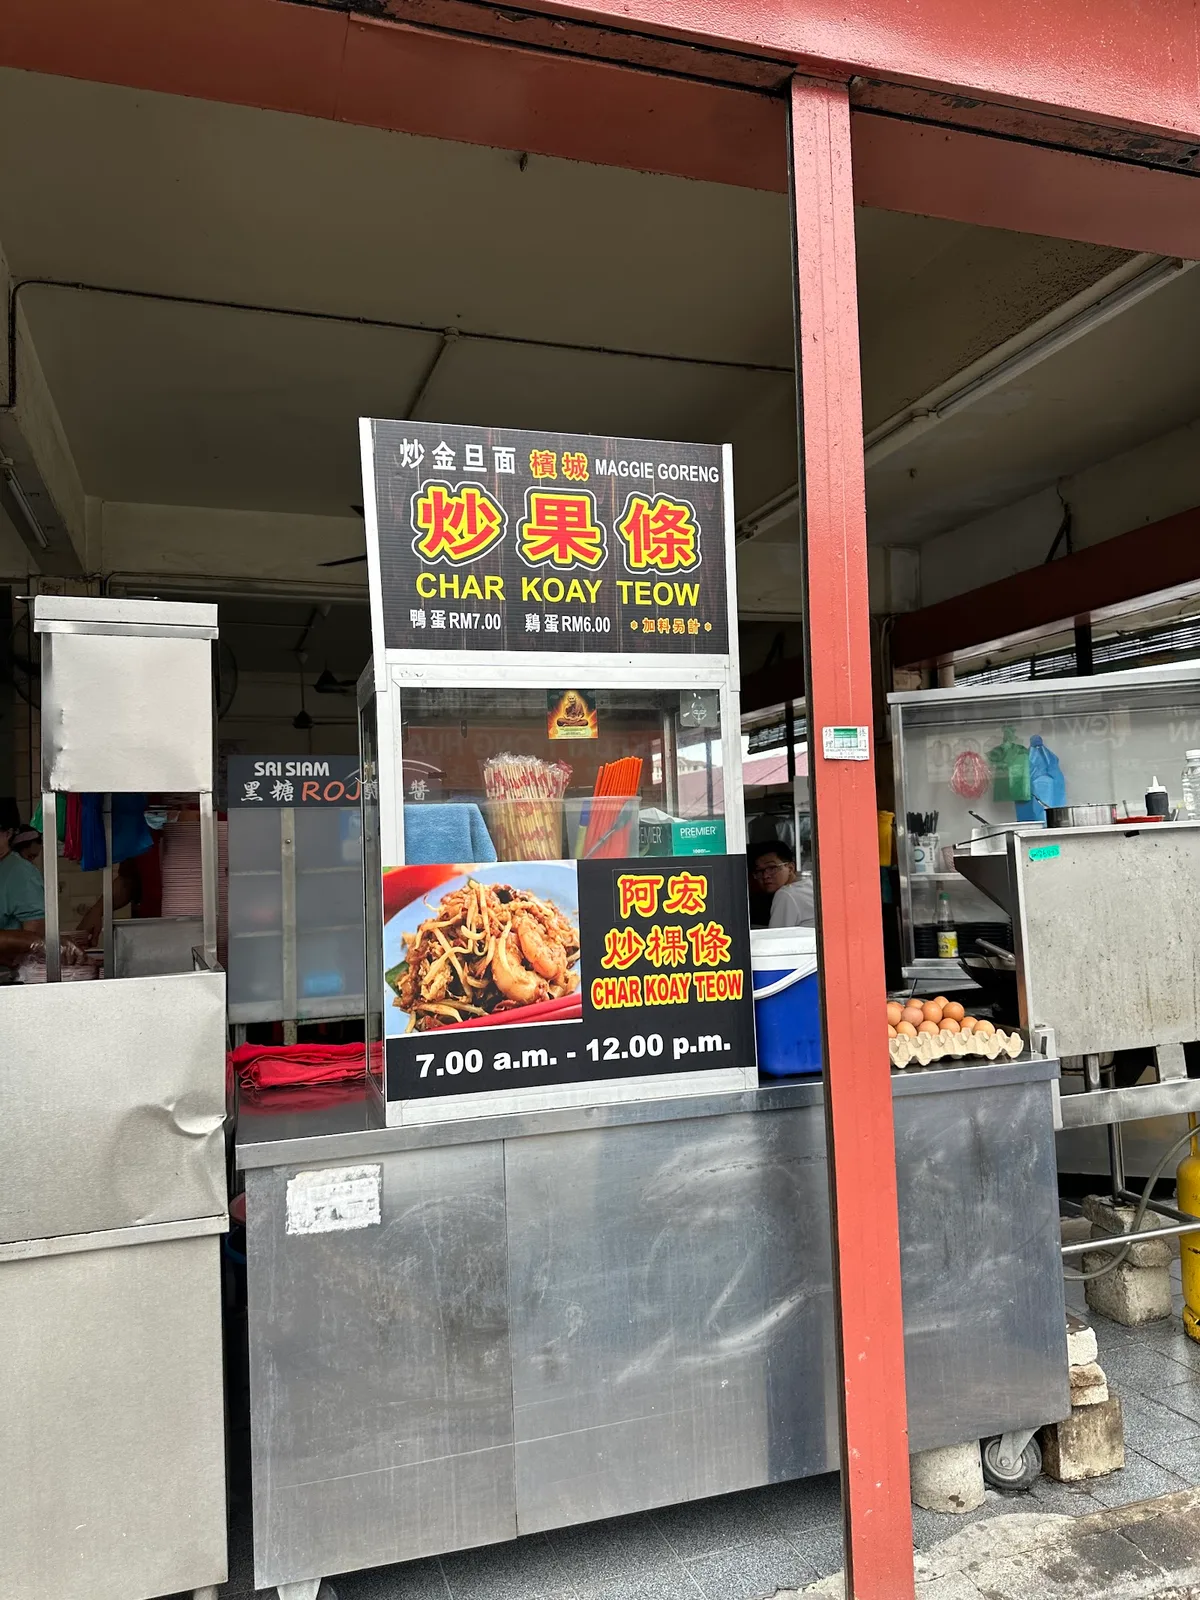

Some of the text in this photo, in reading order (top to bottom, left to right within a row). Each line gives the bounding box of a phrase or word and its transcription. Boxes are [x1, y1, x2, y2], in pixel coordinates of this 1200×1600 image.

[399, 438, 516, 475] 炒金旦面
[530, 449, 590, 482] 檳城
[595, 459, 720, 483] MAGGIE GORENG
[415, 480, 700, 572] 炒果條
[415, 572, 700, 607] CHAR KOAY TEOW
[409, 608, 502, 630] 鴨蛋 RM7.00
[561, 615, 612, 634] RM6.00
[642, 617, 701, 635] 加料另計
[254, 761, 330, 777] SRI SIAM
[240, 780, 295, 802] 黑糖
[302, 780, 361, 802] ROJ
[680, 825, 716, 837] PREMIER
[617, 872, 708, 919] 阿宏
[590, 968, 744, 1010] CHAR KOAY TEOW
[415, 1033, 732, 1078] 7.00 a.m. - 12.00 p.m.
